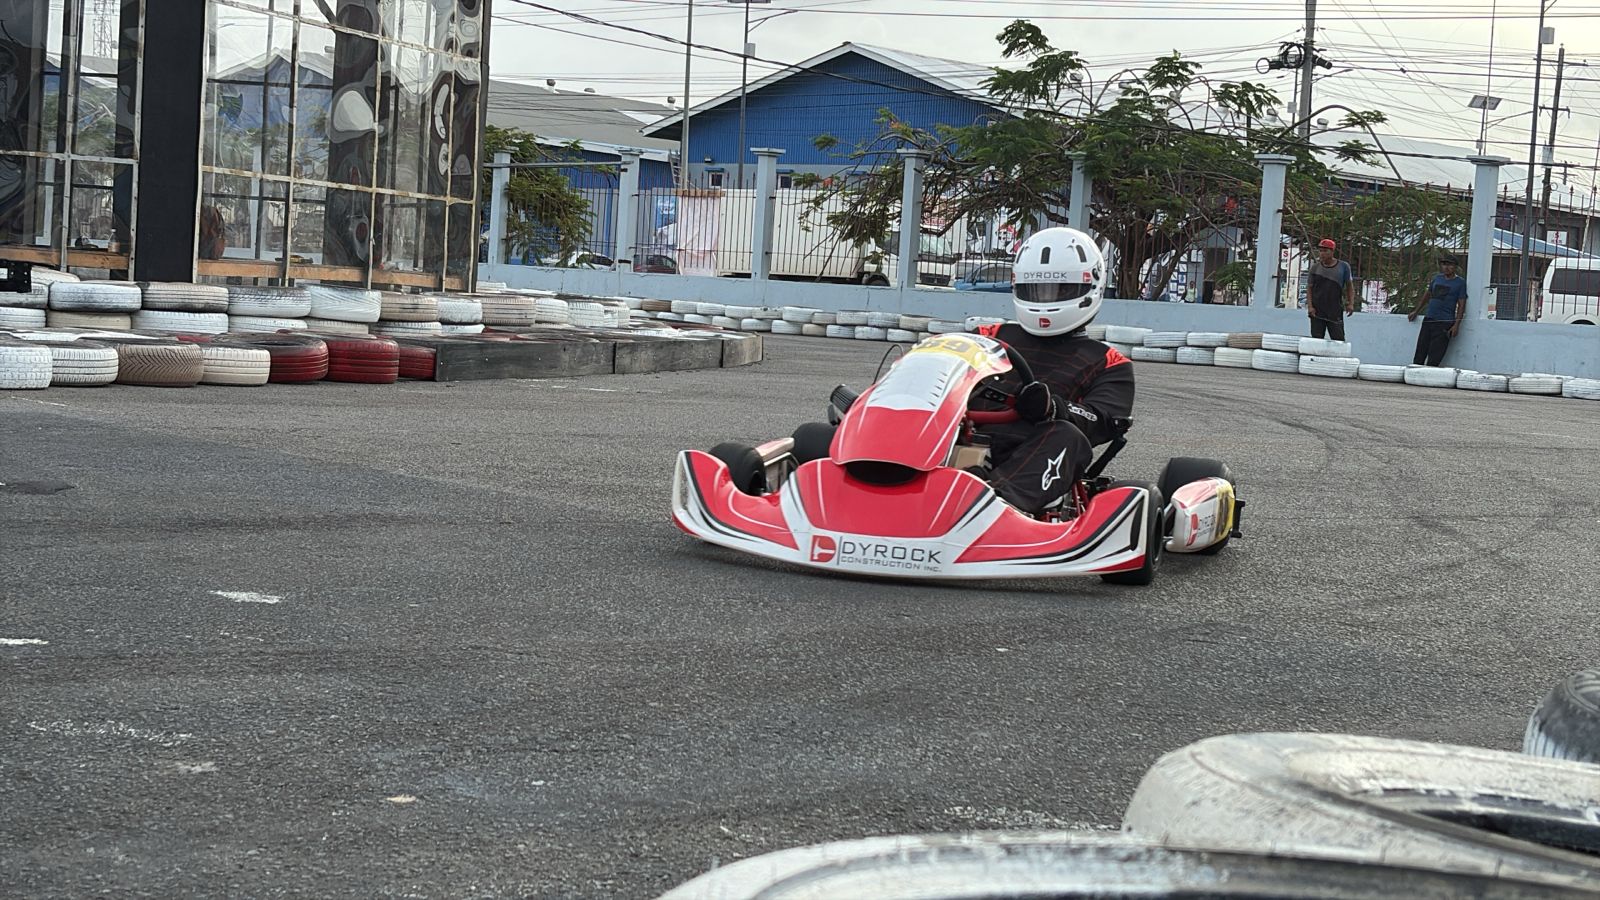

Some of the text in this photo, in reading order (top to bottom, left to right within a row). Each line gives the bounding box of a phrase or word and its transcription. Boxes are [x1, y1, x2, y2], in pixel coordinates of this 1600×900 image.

[1023, 271, 1068, 280] DYROCK
[841, 541, 942, 564] DYROCK
[840, 555, 920, 570] CONSTRUCTION
